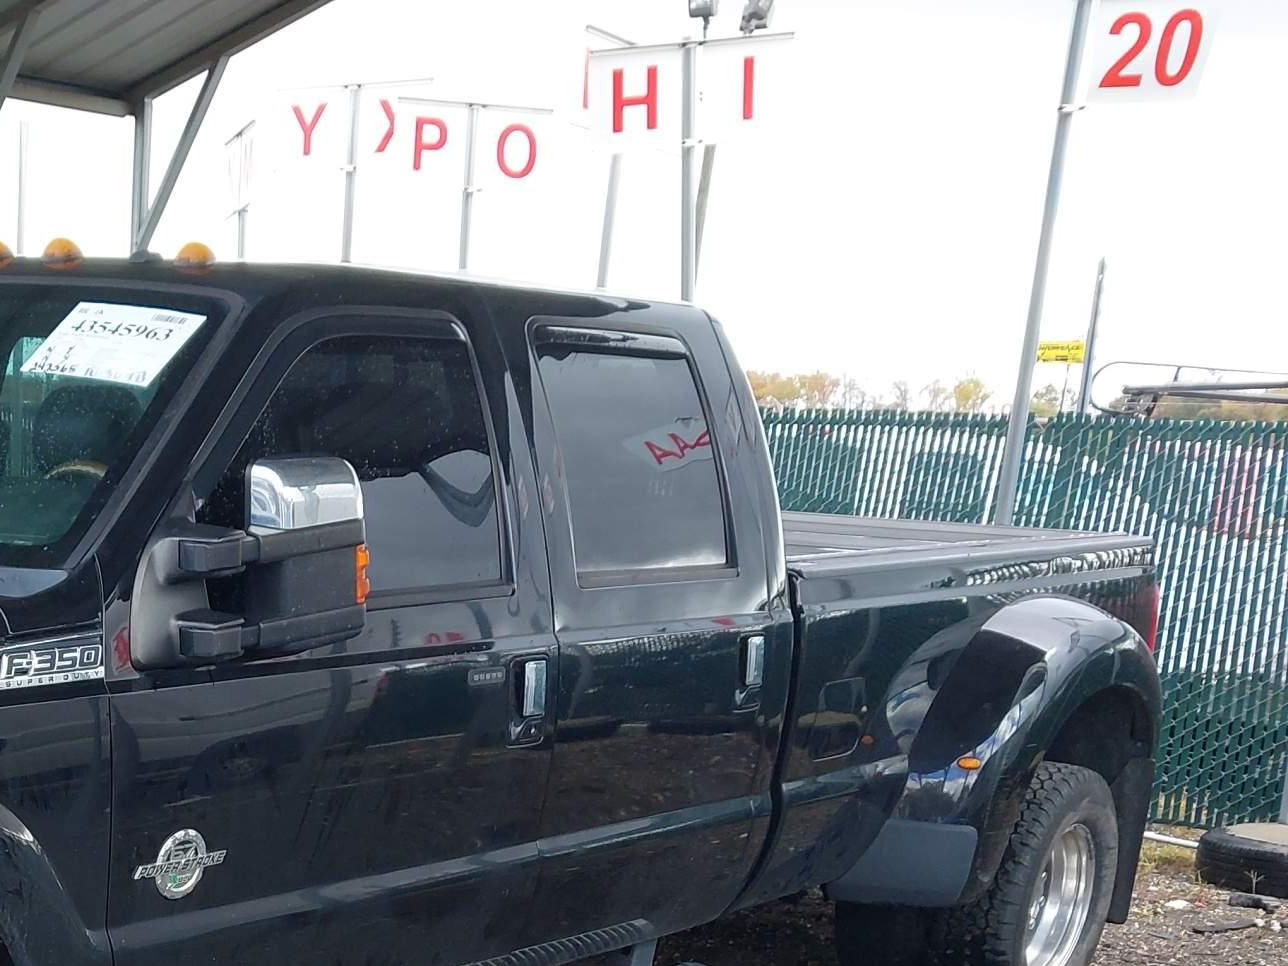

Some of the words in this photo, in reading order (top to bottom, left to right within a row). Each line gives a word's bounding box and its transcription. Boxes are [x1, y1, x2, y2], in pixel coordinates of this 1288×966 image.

[1098, 8, 1204, 88] 20
[612, 65, 658, 133] H
[742, 55, 755, 120] I
[291, 102, 328, 156] Y
[412, 116, 448, 171] P
[496, 122, 538, 179] O
[71, 319, 175, 341] 43545963
[1, 644, 103, 680] F-350
[5, 675, 55, 688] SUPER
[63, 671, 101, 681] DUTY
